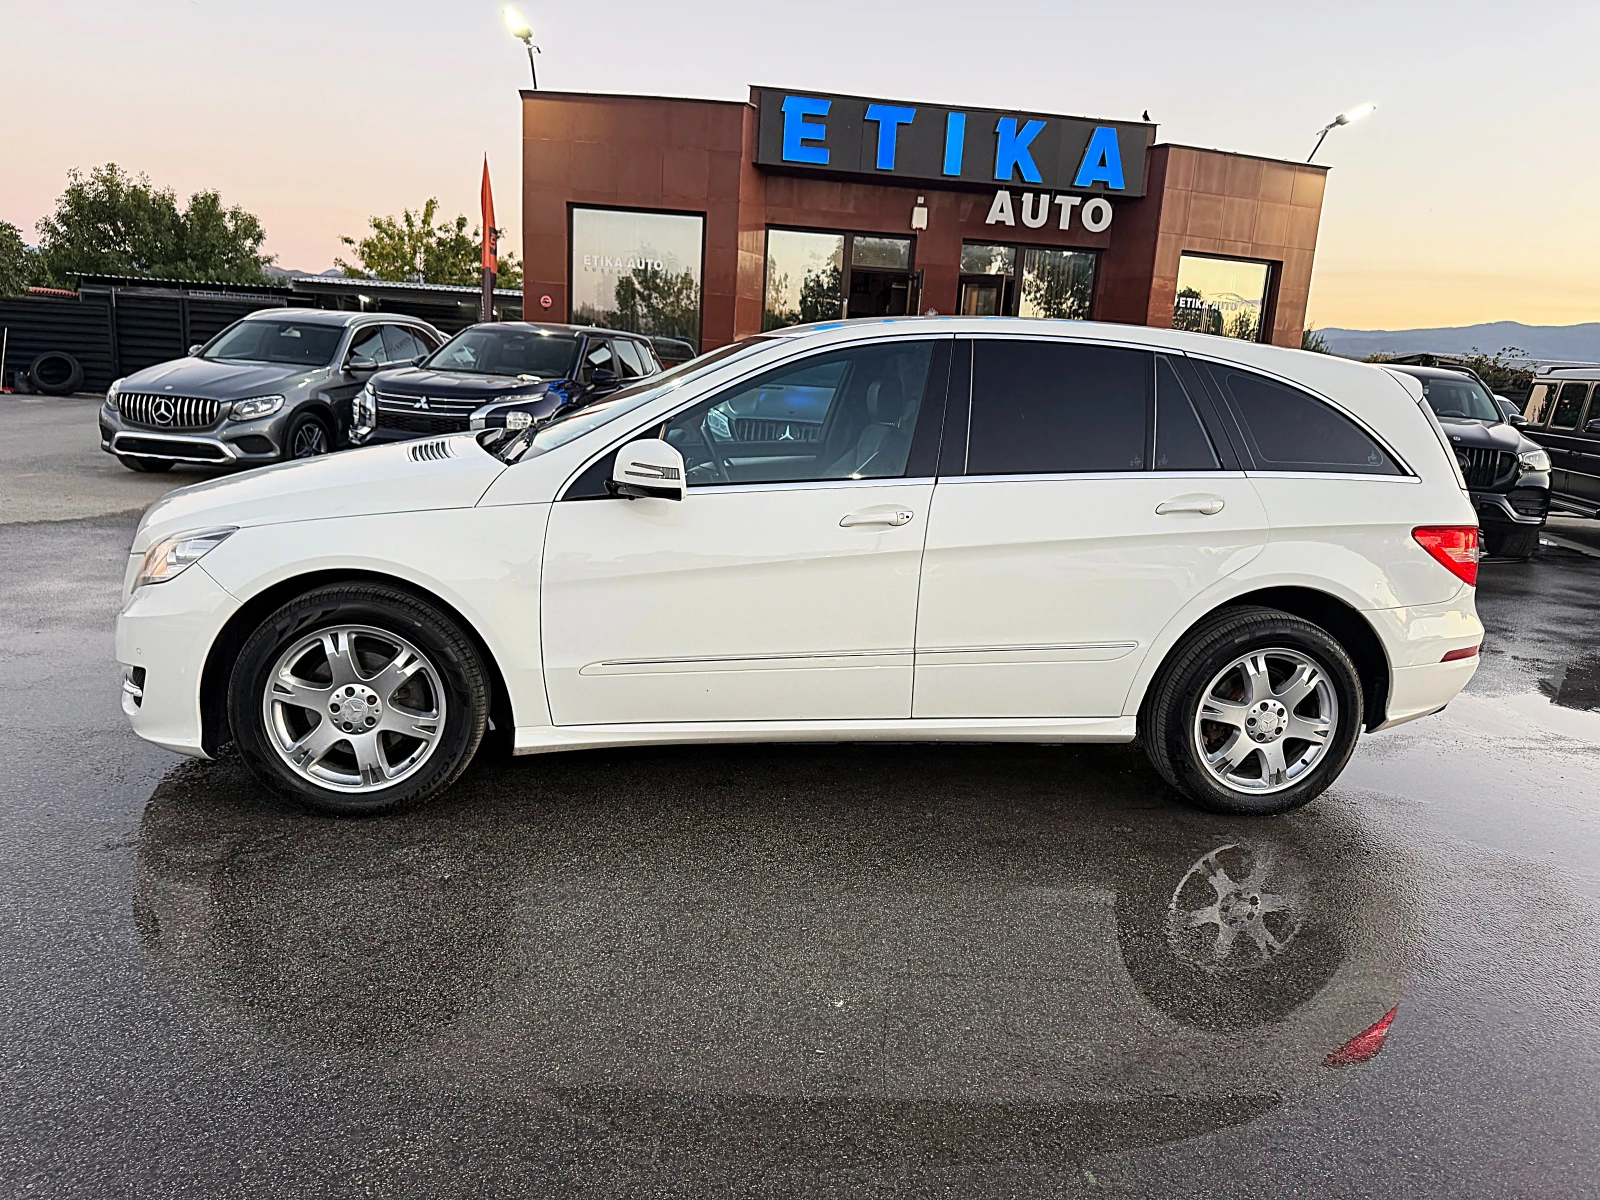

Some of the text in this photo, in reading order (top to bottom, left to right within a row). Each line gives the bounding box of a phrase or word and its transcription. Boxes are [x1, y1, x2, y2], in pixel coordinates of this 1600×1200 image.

[781, 95, 1125, 190] ETIKA
[985, 189, 1113, 232] AUTO
[583, 255, 664, 271] ETIKA AUTO
[1179, 297, 1239, 311] ETIKA AUTO
